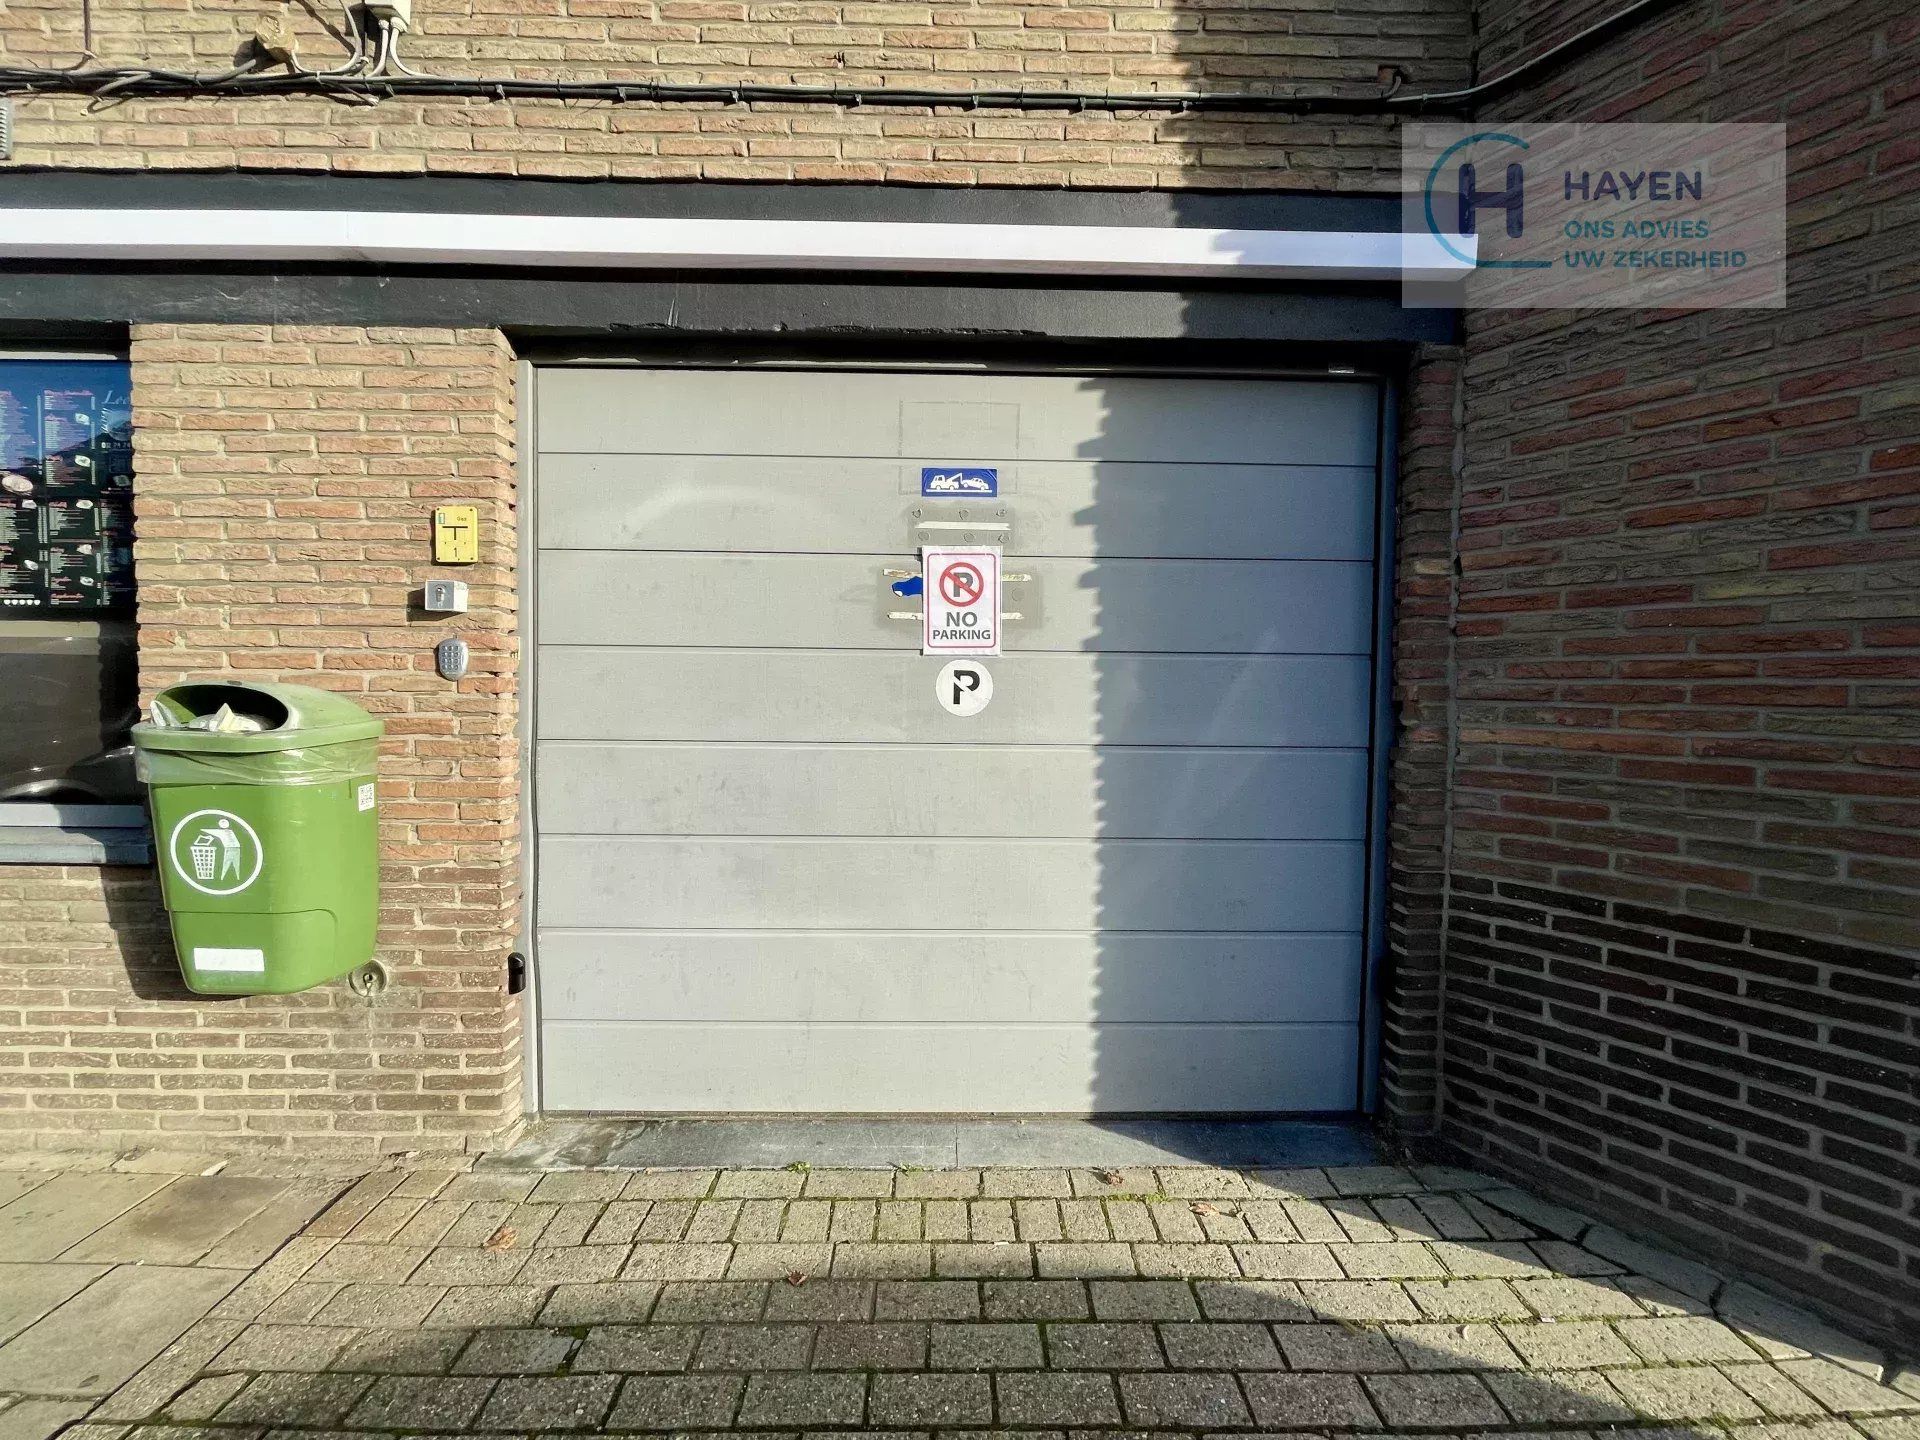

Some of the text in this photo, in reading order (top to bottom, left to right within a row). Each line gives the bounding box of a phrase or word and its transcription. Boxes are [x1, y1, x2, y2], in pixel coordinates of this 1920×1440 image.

[946, 611, 978, 627] NO
[933, 629, 991, 640] PARKING
[953, 669, 981, 705] P
